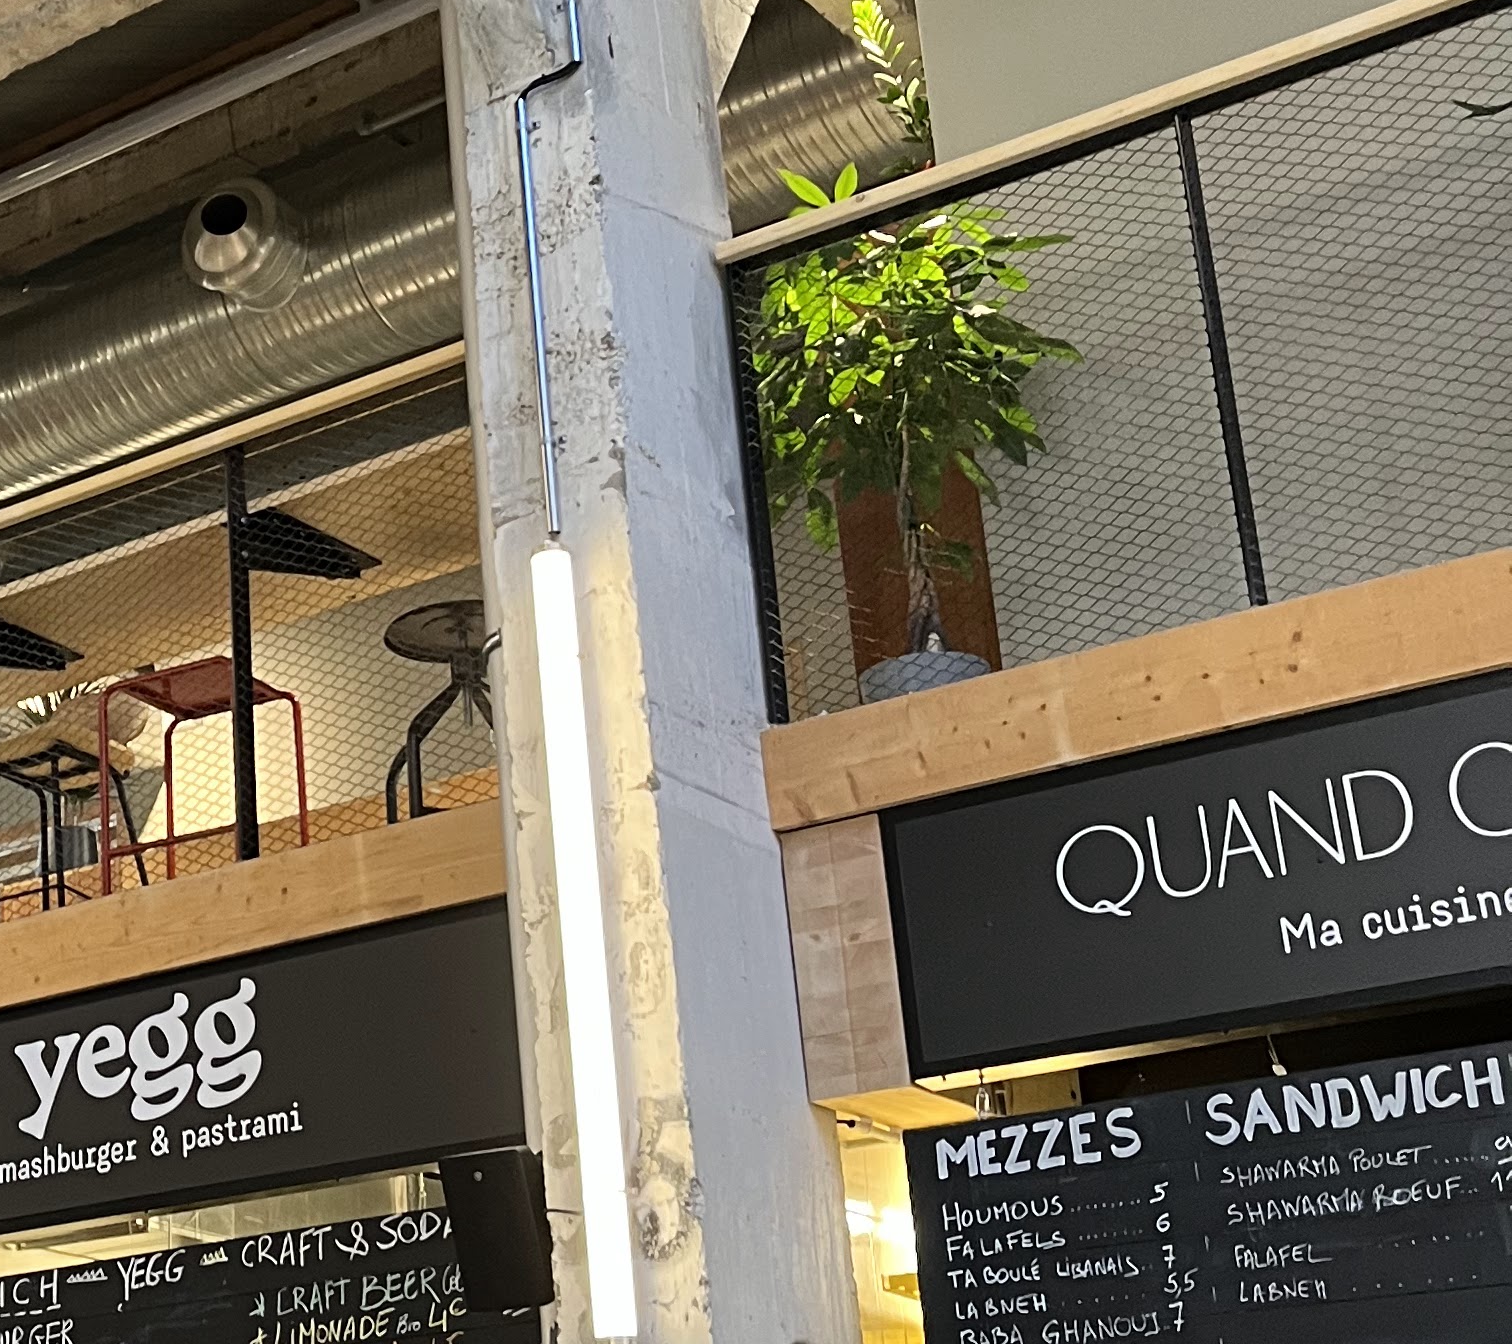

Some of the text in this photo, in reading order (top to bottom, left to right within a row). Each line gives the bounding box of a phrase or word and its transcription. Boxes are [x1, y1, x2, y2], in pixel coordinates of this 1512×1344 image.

[1055, 768, 1415, 918] QUAND
[1279, 912, 1343, 955] Ma
[14, 977, 262, 1140] yegg
[1205, 1057, 1505, 1146] SANDWICH
[150, 1125, 170, 1157] &
[181, 1101, 303, 1158] pastrami
[936, 1106, 1142, 1180] MEZZES
[1220, 1155, 1340, 1188] SHAWARMA
[1348, 1144, 1433, 1173] POULET
[942, 1181, 1169, 1232] HOUMOUS 5
[1227, 1187, 1364, 1226] SHAWARMA
[242, 1225, 333, 1268] CRAFT
[946, 1212, 1171, 1262] FALAFELS 6
[1162, 1244, 1175, 1269] 7
[1234, 1243, 1333, 1270] FALAFEL
[117, 1249, 186, 1300] YEGG
[276, 1276, 350, 1315] CRAFT
[360, 1266, 440, 1312] BEER
[1163, 1267, 1198, 1299] 5,5
[1167, 1301, 1185, 1332] 7
